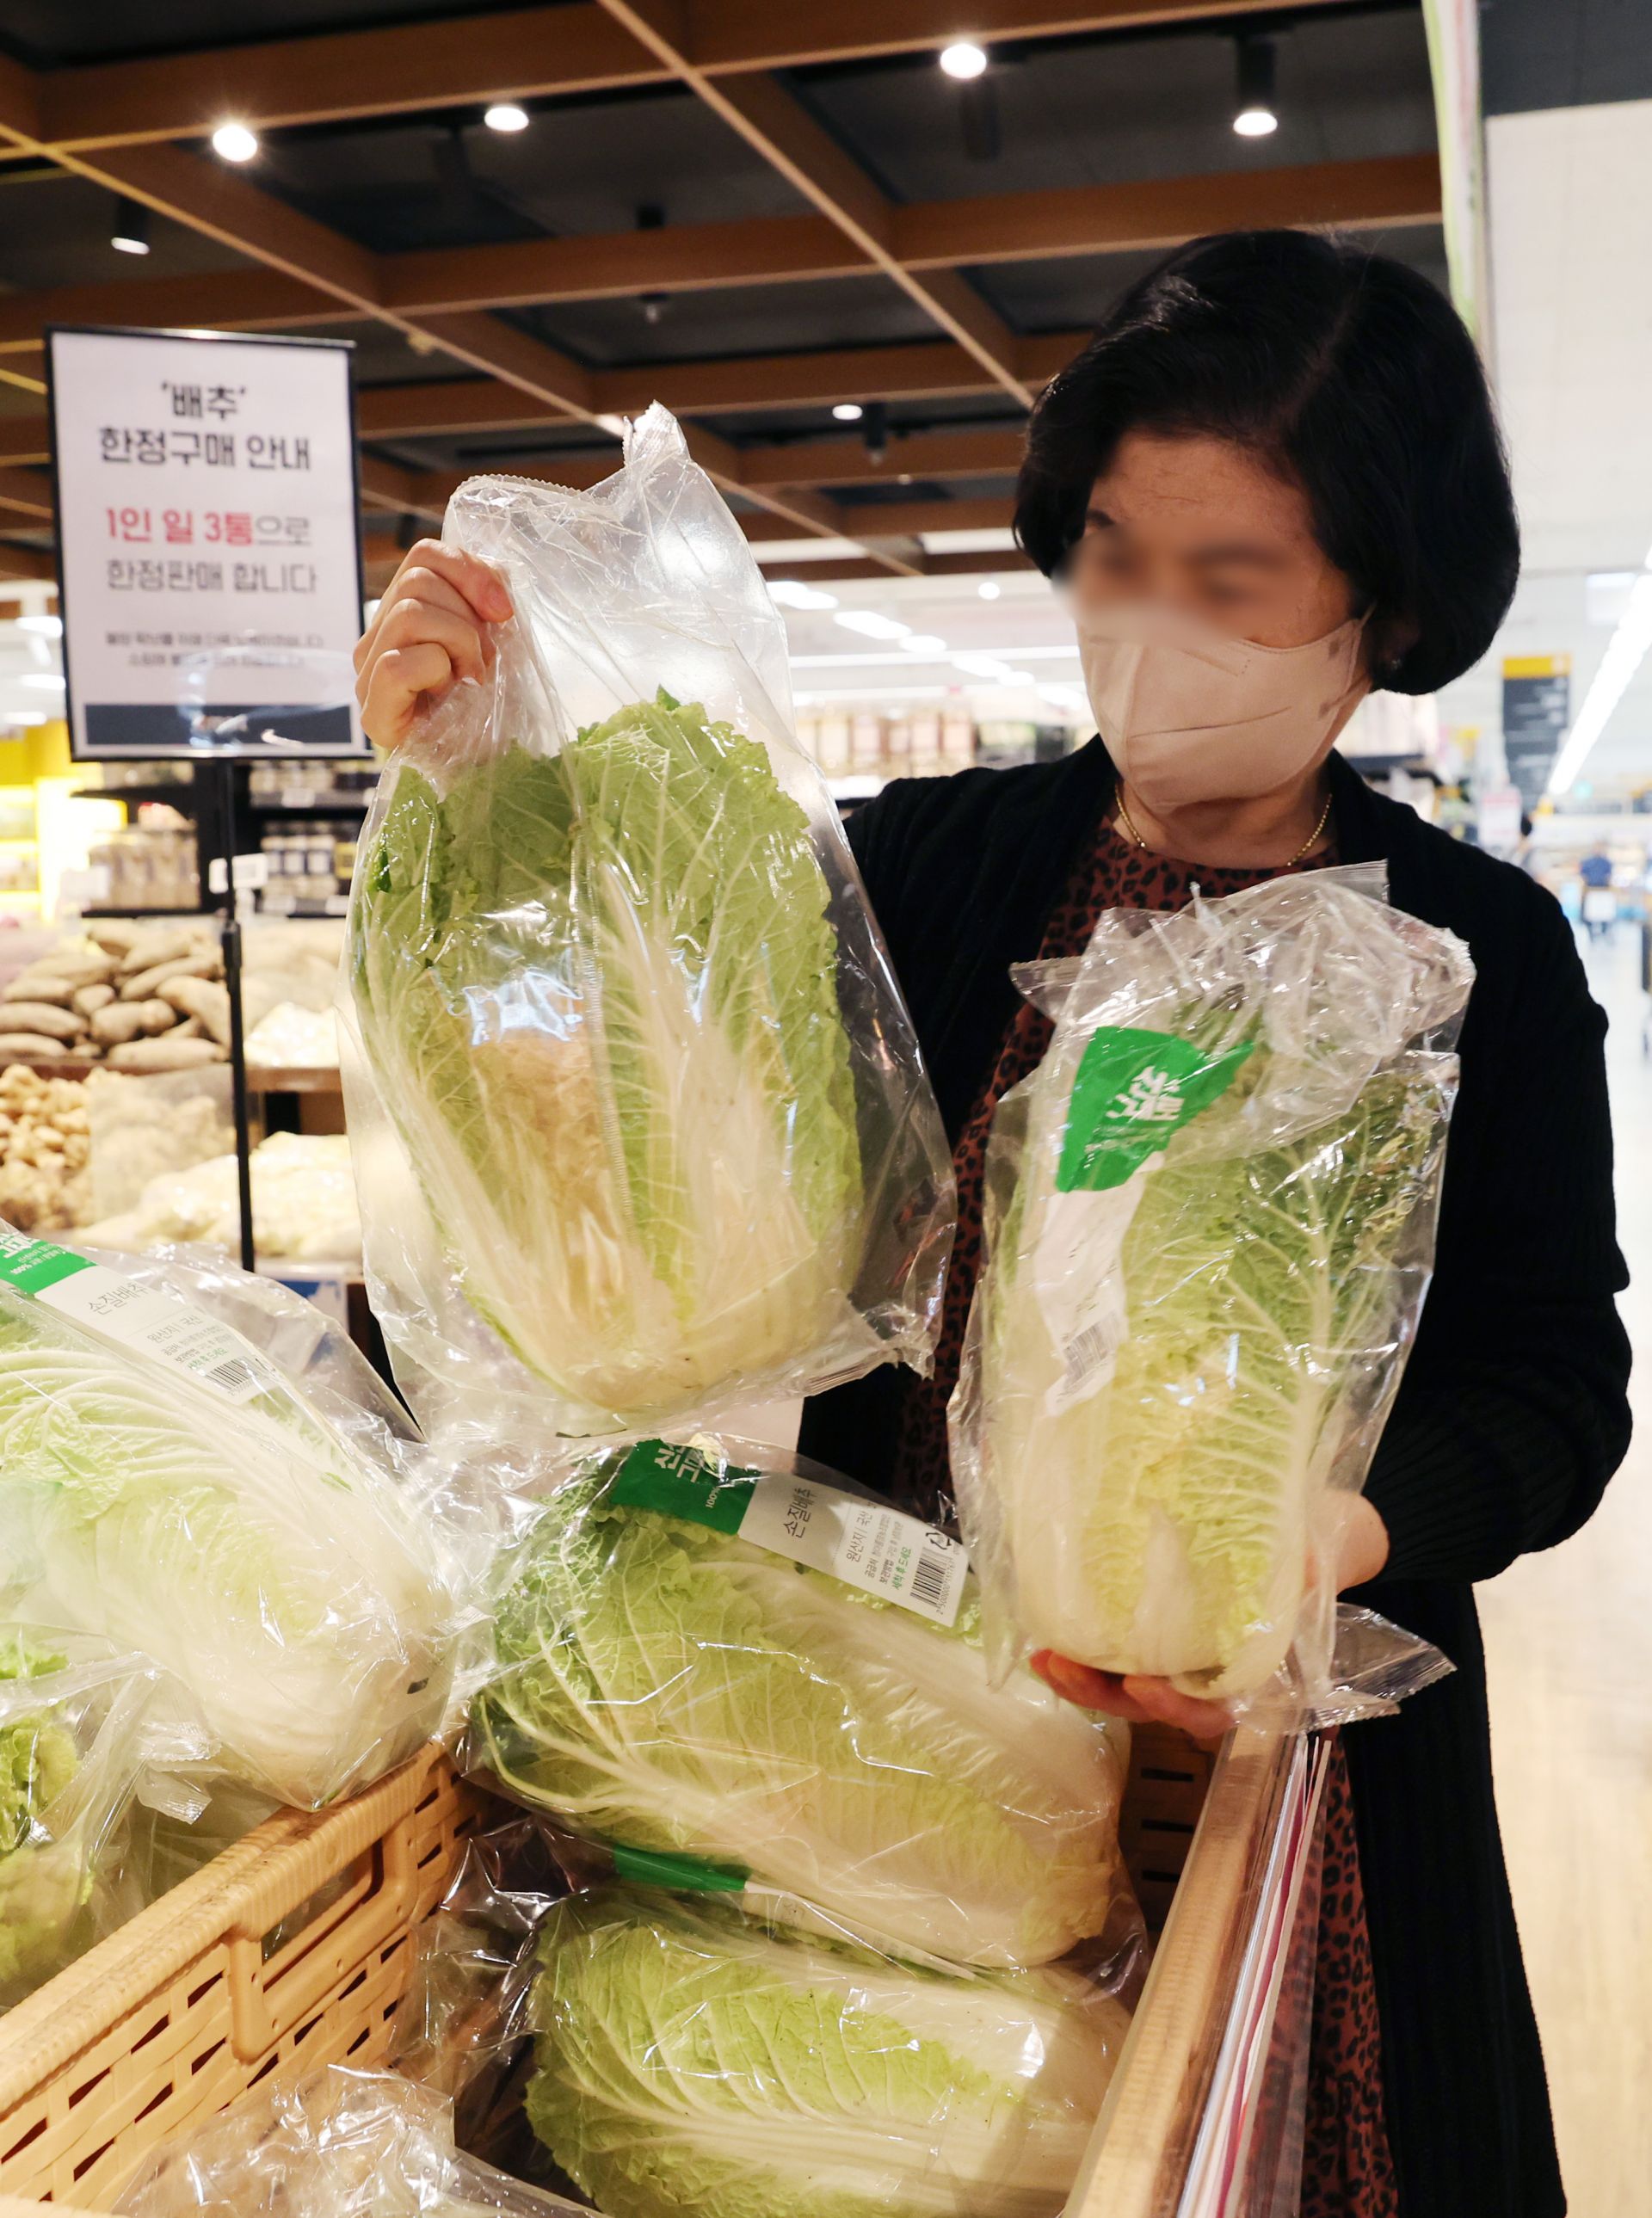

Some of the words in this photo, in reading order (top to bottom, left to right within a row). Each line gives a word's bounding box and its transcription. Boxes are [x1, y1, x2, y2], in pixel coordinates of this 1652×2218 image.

[101, 427, 236, 467] 한정구매
[247, 434, 311, 471] 안내
[107, 507, 152, 544] 1인
[162, 508, 194, 545] 일
[204, 511, 311, 547] 3통으로
[108, 559, 224, 592] 한정판매
[233, 562, 317, 593] 합니다
[88, 1282, 149, 1315] 손질배추
[706, 1486, 722, 1508] 100%
[782, 1487, 818, 1538] 손질배추
[855, 1511, 873, 1526] 국산
[846, 1531, 868, 1562] 원산지
